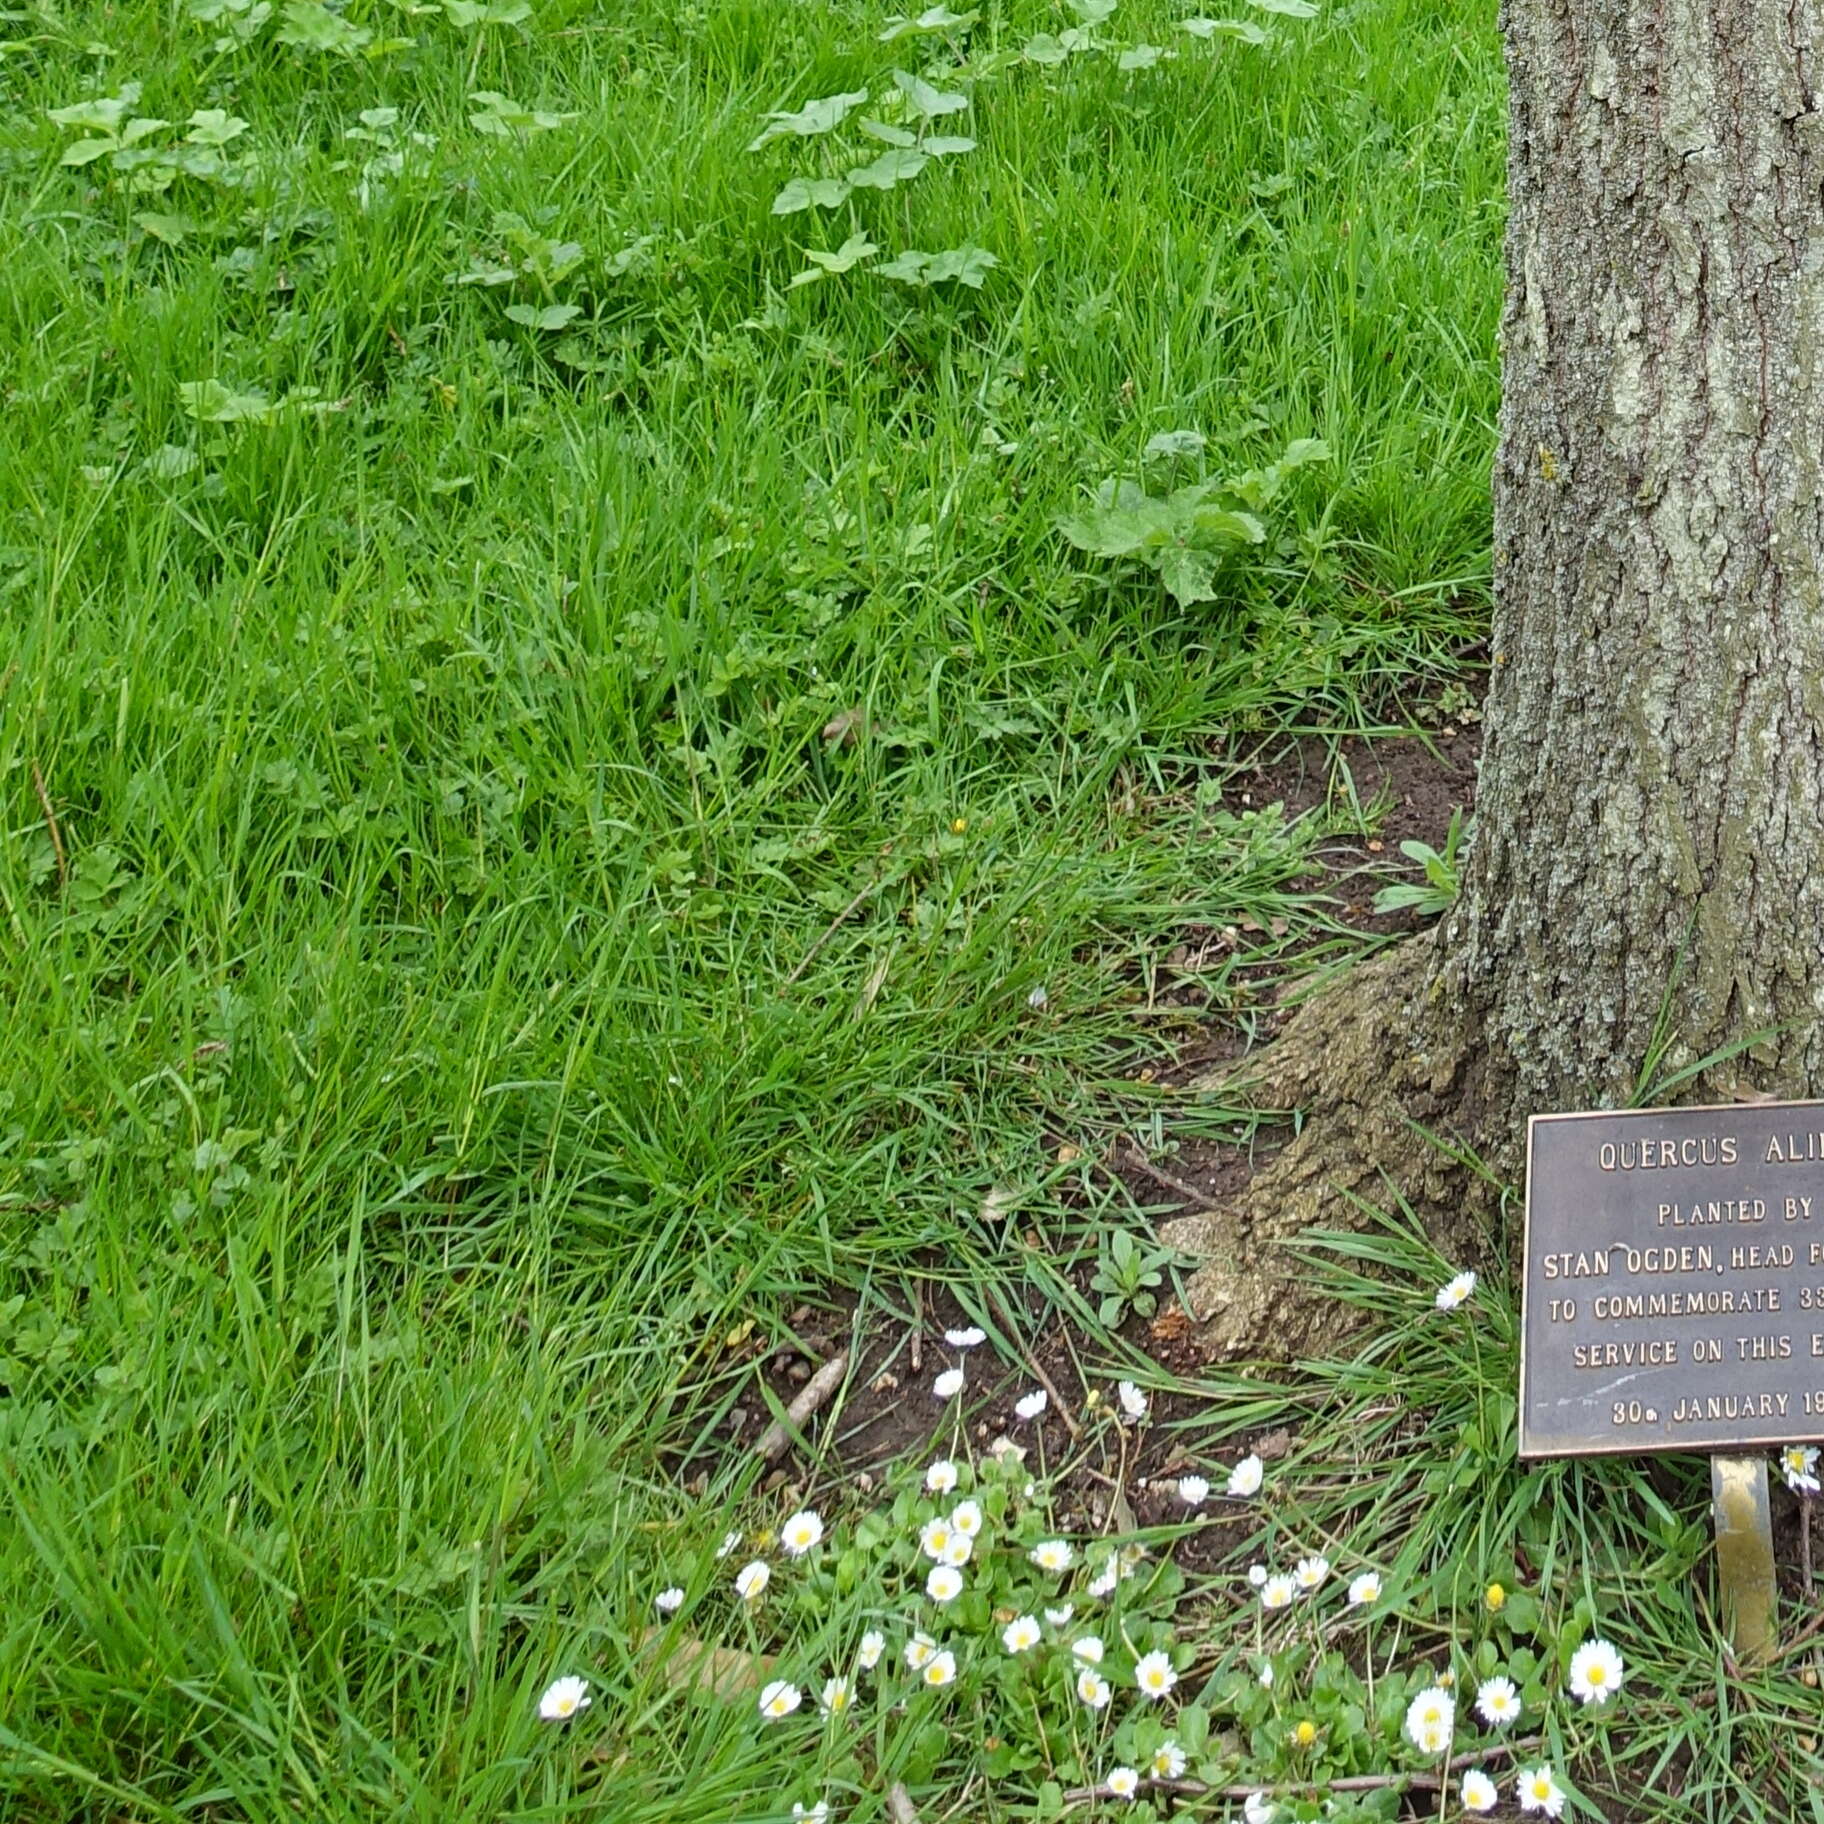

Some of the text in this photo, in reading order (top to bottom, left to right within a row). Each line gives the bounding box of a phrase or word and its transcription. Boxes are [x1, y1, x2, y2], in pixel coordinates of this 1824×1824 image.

[1599, 1137, 1739, 1171] QUERCUS
[1658, 1197, 1814, 1227] PLANTED BY
[1543, 1250, 1610, 1279] STAN
[1626, 1245, 1724, 1276] OGDEN,
[1731, 1243, 1795, 1269] HEAD
[1549, 1299, 1577, 1321] TO
[1594, 1289, 1782, 1319] COMMEMORATE
[1573, 1340, 1678, 1368] SERVICE
[1693, 1339, 1723, 1362] ON
[1736, 1335, 1792, 1360] THIS
[1672, 1393, 1789, 1422] JANUARY
